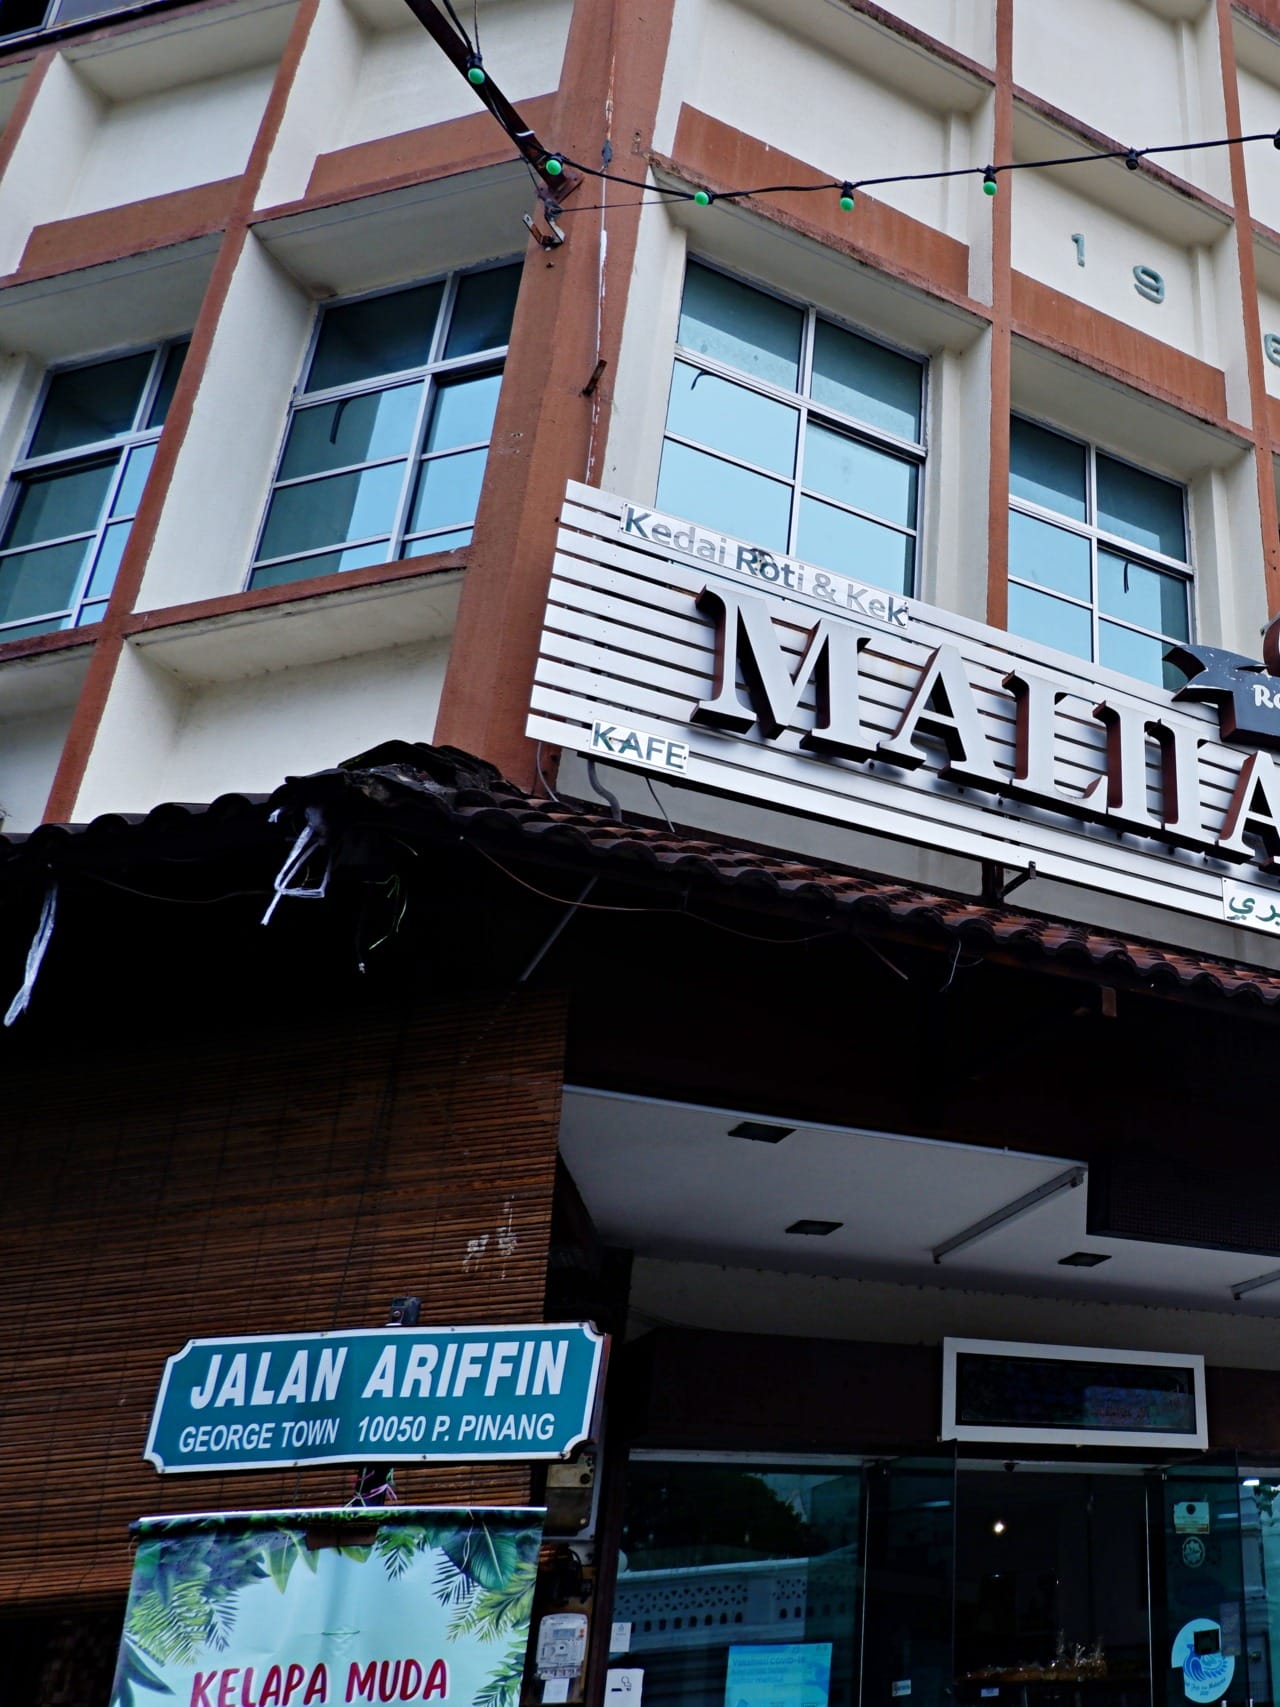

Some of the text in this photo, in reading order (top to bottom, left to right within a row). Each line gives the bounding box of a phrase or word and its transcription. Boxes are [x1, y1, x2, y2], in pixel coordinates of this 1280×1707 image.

[624, 506, 909, 628] Kedai Roti & Kek
[592, 722, 687, 770] KAFE
[190, 1340, 569, 1410] JALAN ARIFFIN
[179, 1412, 555, 1454] GEORGE TOWN 10050 P. PINANG
[190, 1658, 449, 1707] KELAPA MUDA
